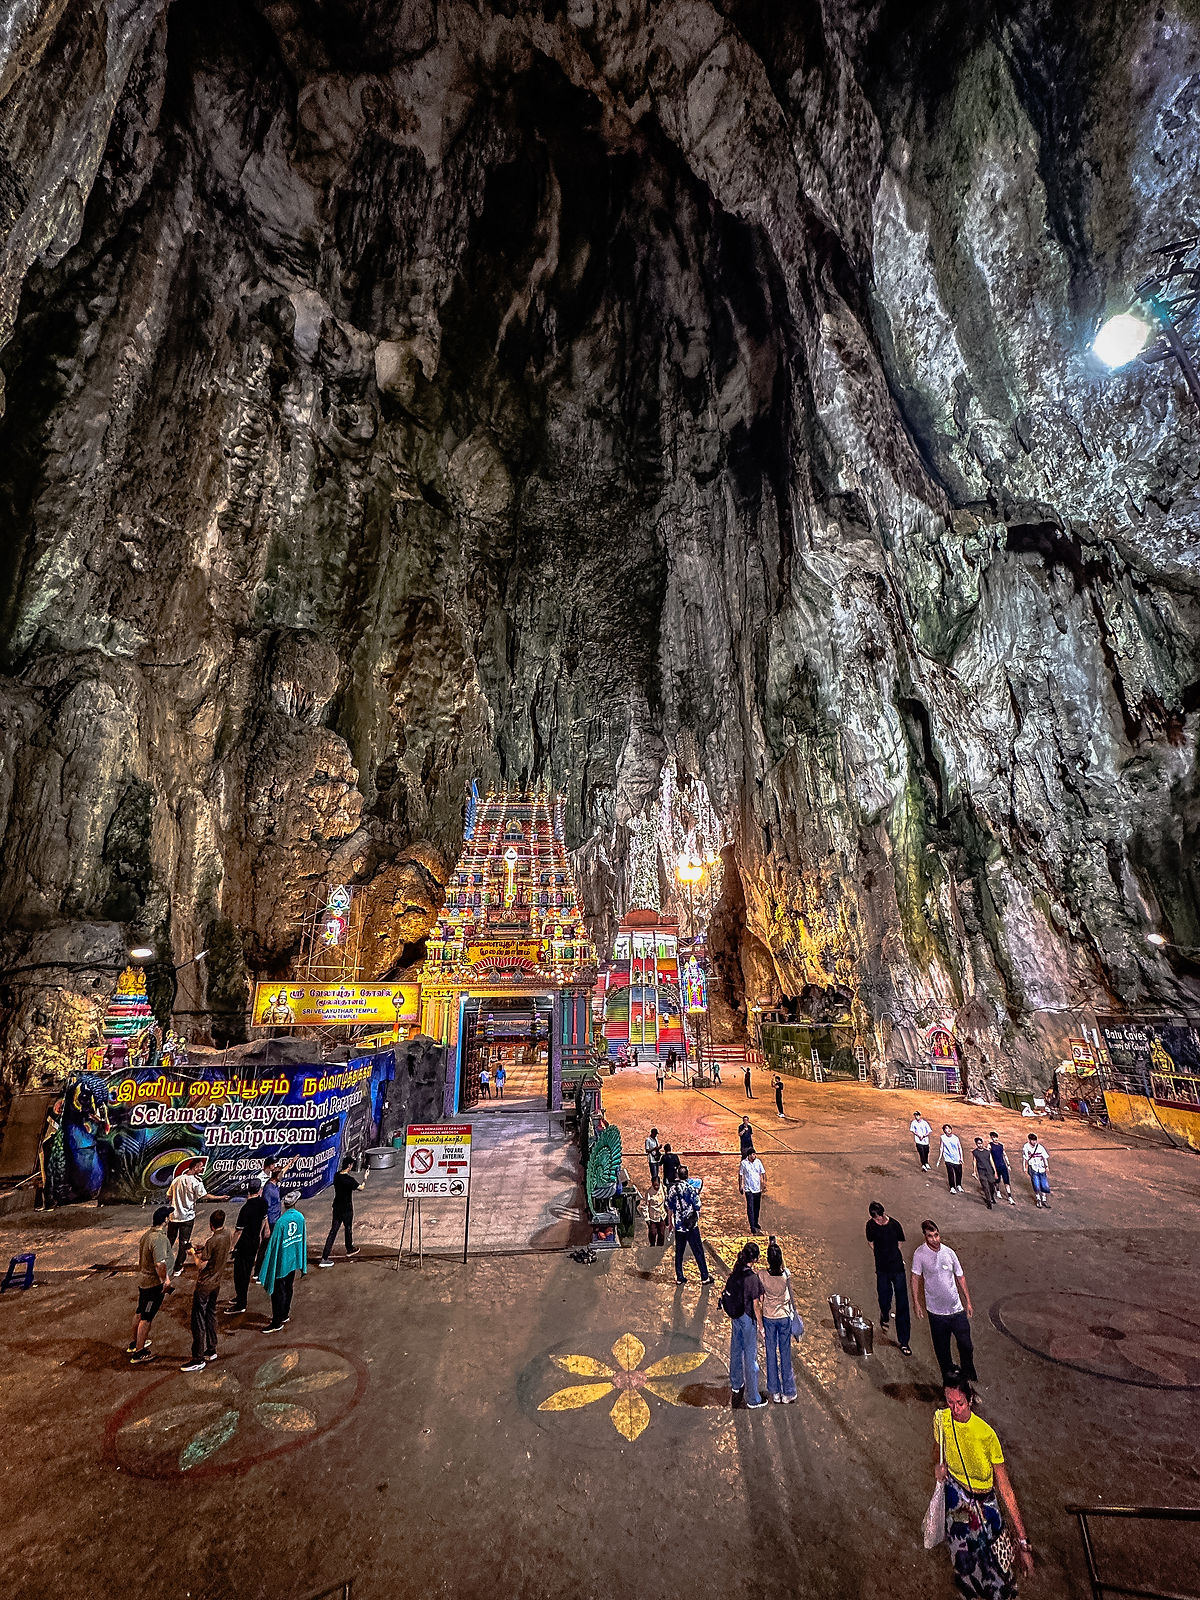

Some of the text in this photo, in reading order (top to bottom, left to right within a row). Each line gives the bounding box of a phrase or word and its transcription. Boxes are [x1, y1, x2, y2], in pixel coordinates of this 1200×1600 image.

[117, 1076, 184, 1102] இனிய
[190, 1074, 289, 1100] தைப்பூசம்
[131, 1102, 218, 1125] Selamat
[220, 1097, 329, 1129] Menyambut
[204, 1125, 317, 1149] Thaipusam
[213, 1159, 234, 1171] CTI
[405, 1182, 448, 1193] NO SHOES
